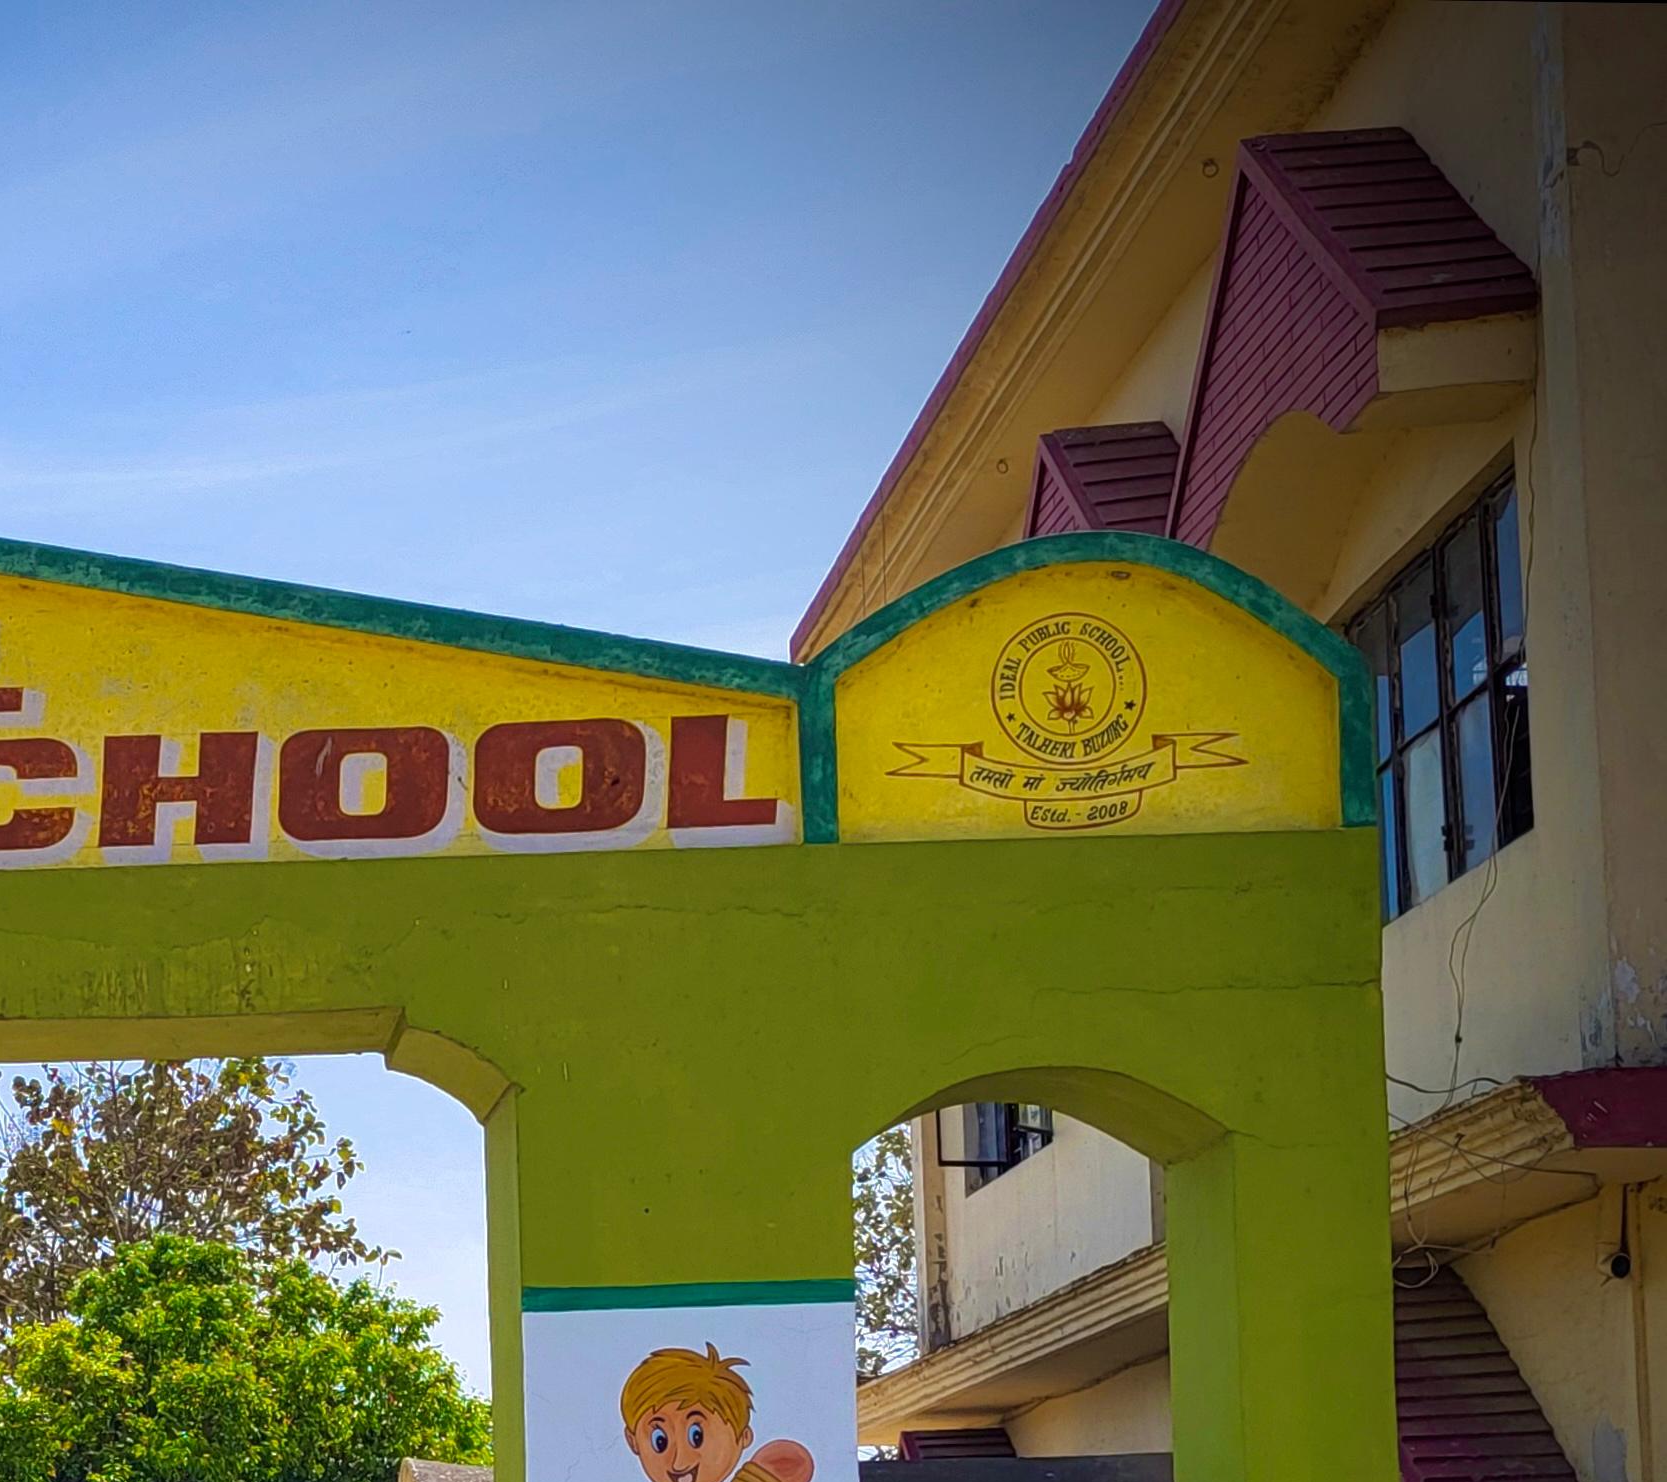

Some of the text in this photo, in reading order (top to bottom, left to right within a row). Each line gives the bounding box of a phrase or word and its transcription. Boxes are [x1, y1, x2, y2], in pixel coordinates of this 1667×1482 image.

[999, 656, 1022, 701] IDEAL
[1017, 621, 1072, 653] PUBLIC
[1015, 722, 1077, 759] TALHERI
[969, 764, 1016, 790] तमसो
[1086, 800, 1129, 821] 2008
